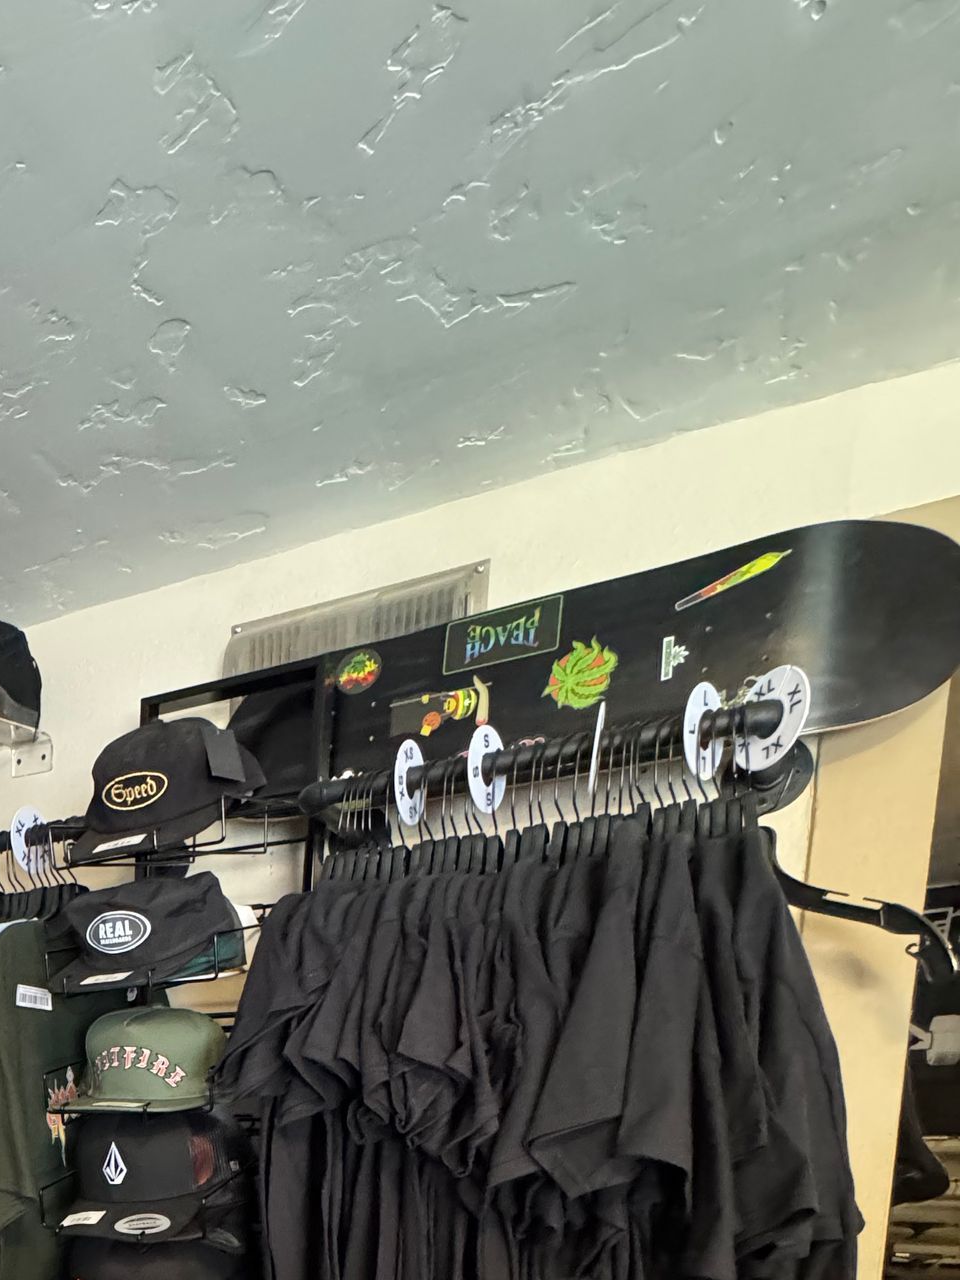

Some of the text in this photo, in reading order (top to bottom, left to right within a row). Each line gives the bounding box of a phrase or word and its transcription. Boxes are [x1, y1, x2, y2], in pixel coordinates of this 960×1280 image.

[483, 734, 490, 748] S
[111, 776, 157, 806] Speed
[98, 919, 133, 939] REAL
